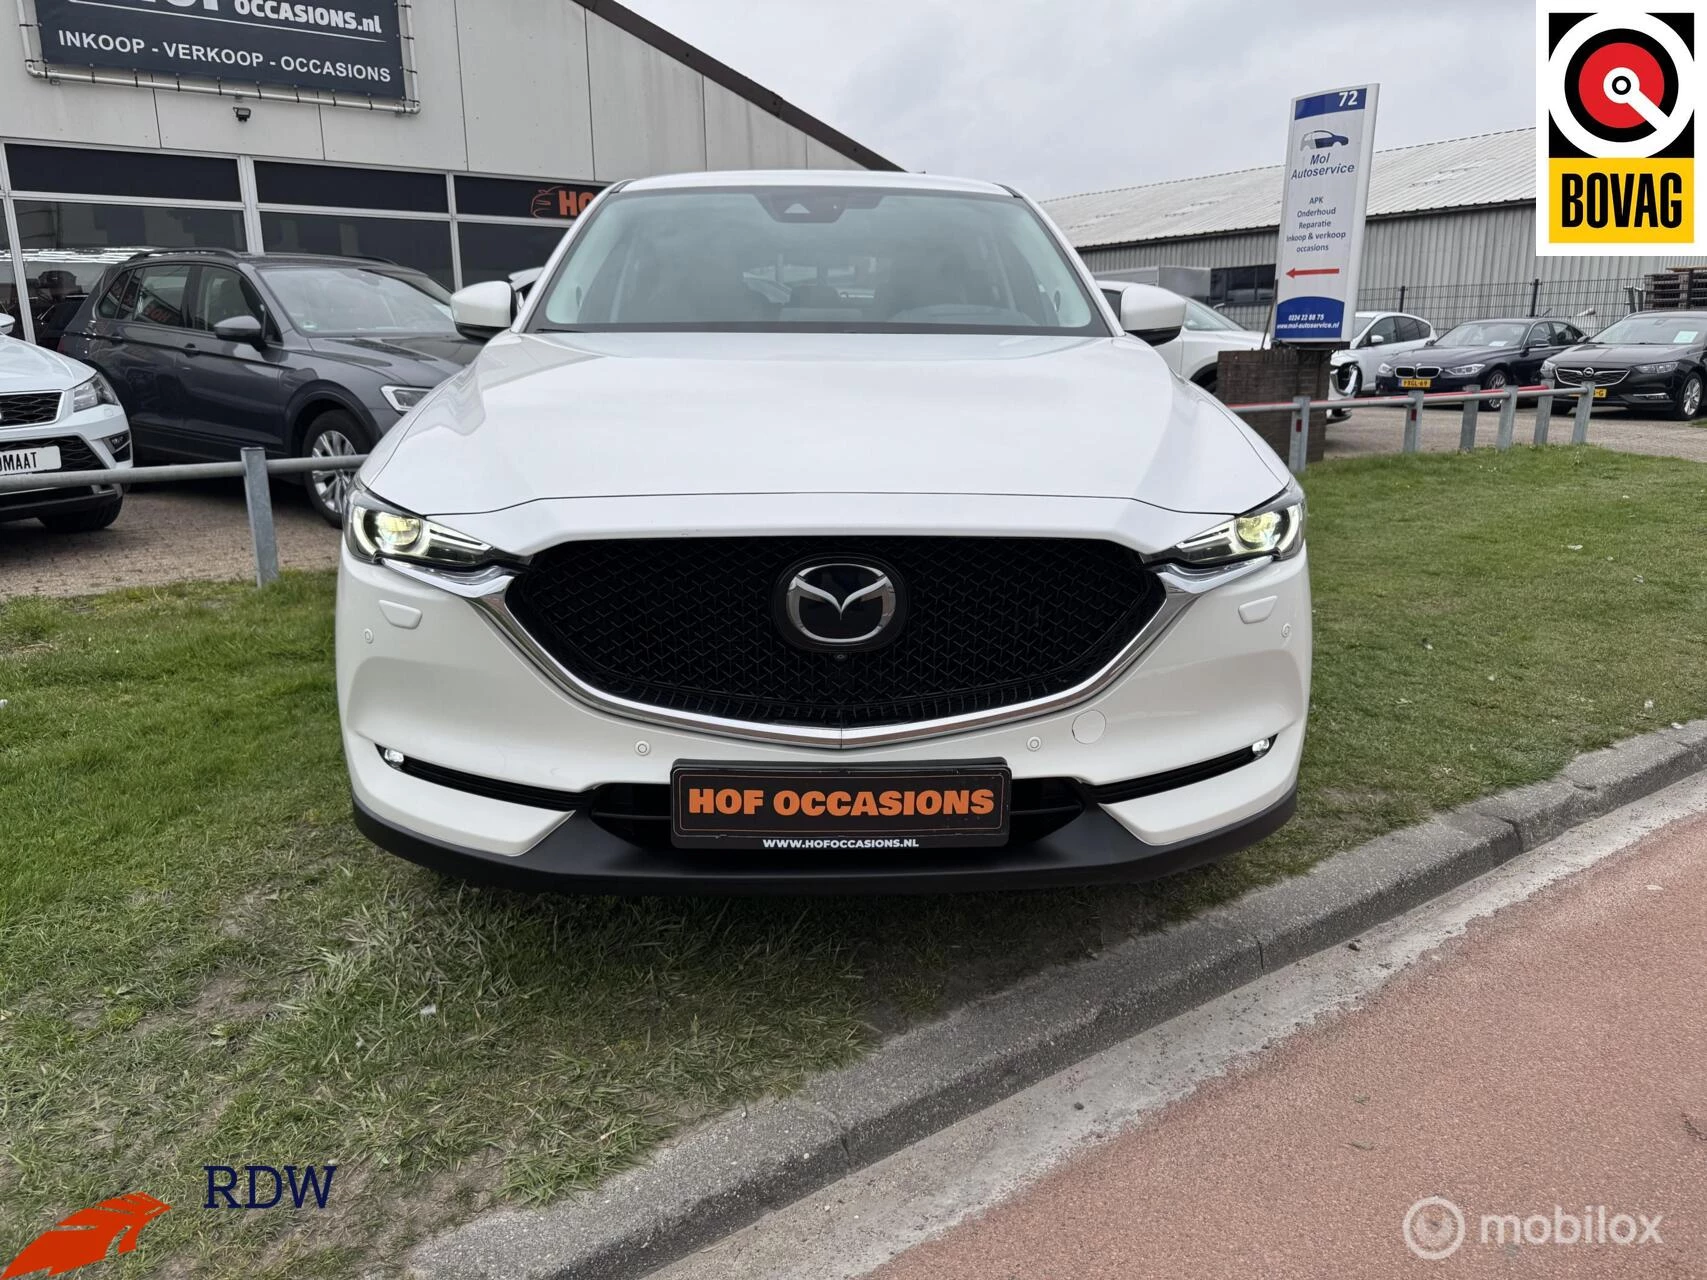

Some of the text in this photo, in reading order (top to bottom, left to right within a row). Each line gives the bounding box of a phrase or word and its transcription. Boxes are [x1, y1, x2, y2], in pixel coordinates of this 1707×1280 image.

[234, 0, 382, 33] OCCASIONS.nl
[58, 30, 145, 54] INKOOP
[163, 42, 264, 68] VERKOOP
[280, 56, 391, 82] OCCASIONS
[1338, 90, 1358, 107] 72
[1310, 152, 1330, 165] Mol
[1291, 163, 1355, 180] Autoservice
[1309, 196, 1324, 204] APK
[1297, 207, 1336, 218] Onderhoud
[1299, 219, 1331, 229] Reparatie
[1307, 232, 1313, 240] &
[1315, 231, 1346, 240] verkoop
[1296, 244, 1329, 253] occasions
[0, 452, 37, 471] MAAT
[688, 788, 995, 816] HOF OCCASIONS
[762, 838, 919, 848] WWW.HOFOCCASIONS.NL
